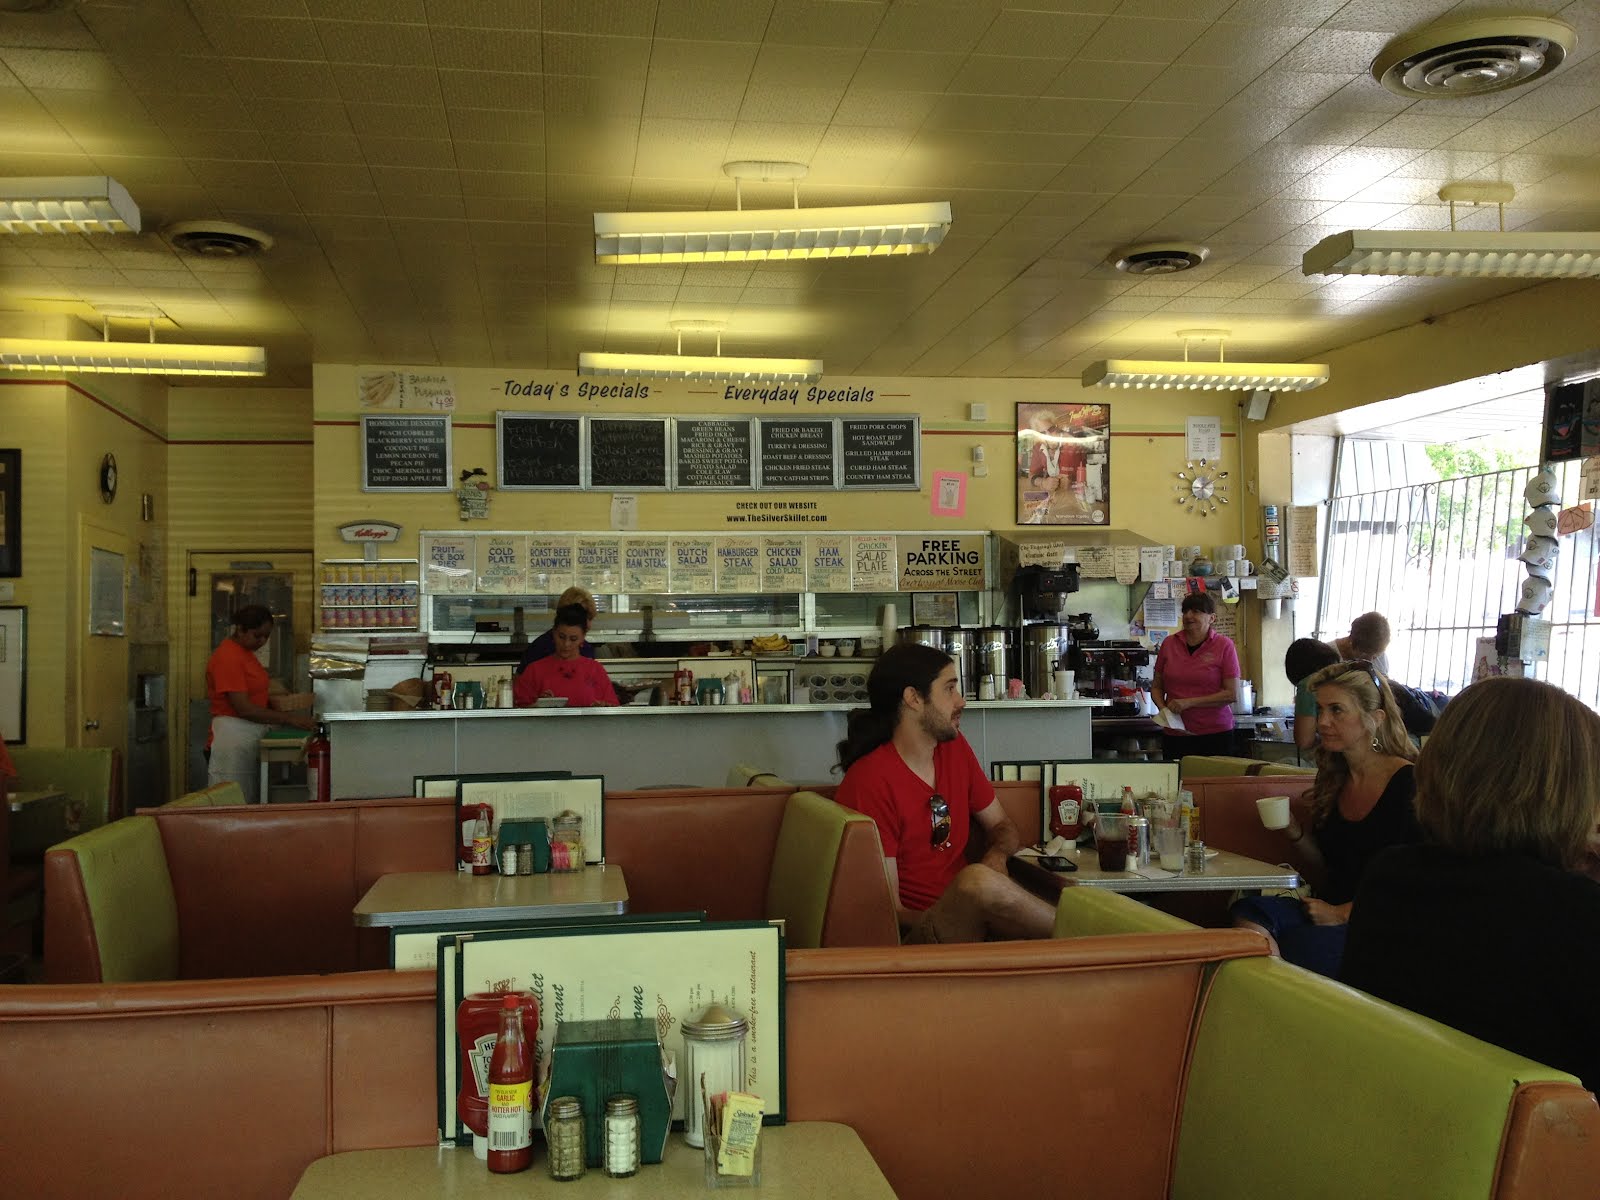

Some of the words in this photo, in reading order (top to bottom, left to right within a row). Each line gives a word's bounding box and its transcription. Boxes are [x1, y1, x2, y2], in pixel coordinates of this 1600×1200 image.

[504, 380, 570, 400] Today's
[578, 382, 650, 400] Specials
[724, 386, 800, 405] Everyday
[806, 386, 874, 405] Specials
[726, 514, 827, 522] www.TheSilverSkillet.com
[354, 528, 388, 538] Kellogg's
[922, 540, 960, 552] FREE
[489, 548, 513, 556] COLD
[530, 548, 552, 557] ROAST
[554, 548, 571, 557] BEEF
[626, 549, 665, 557] COUNTRY
[718, 548, 758, 557] HAMBURGER
[766, 548, 801, 557] CHICKEN
[819, 548, 839, 556] HAM
[856, 551, 887, 561] SALAD
[724, 558, 753, 567] STEAK
[769, 558, 798, 566] SALAD
[814, 558, 844, 566] STEAK
[907, 551, 979, 565] PARKING
[530, 558, 571, 568] SANDWICH
[626, 559, 642, 568] HAM
[644, 559, 667, 568] STEAK
[857, 561, 888, 571] PLATE
[750, 998, 760, 1044] smoke-free
[748, 1069, 757, 1086] This
